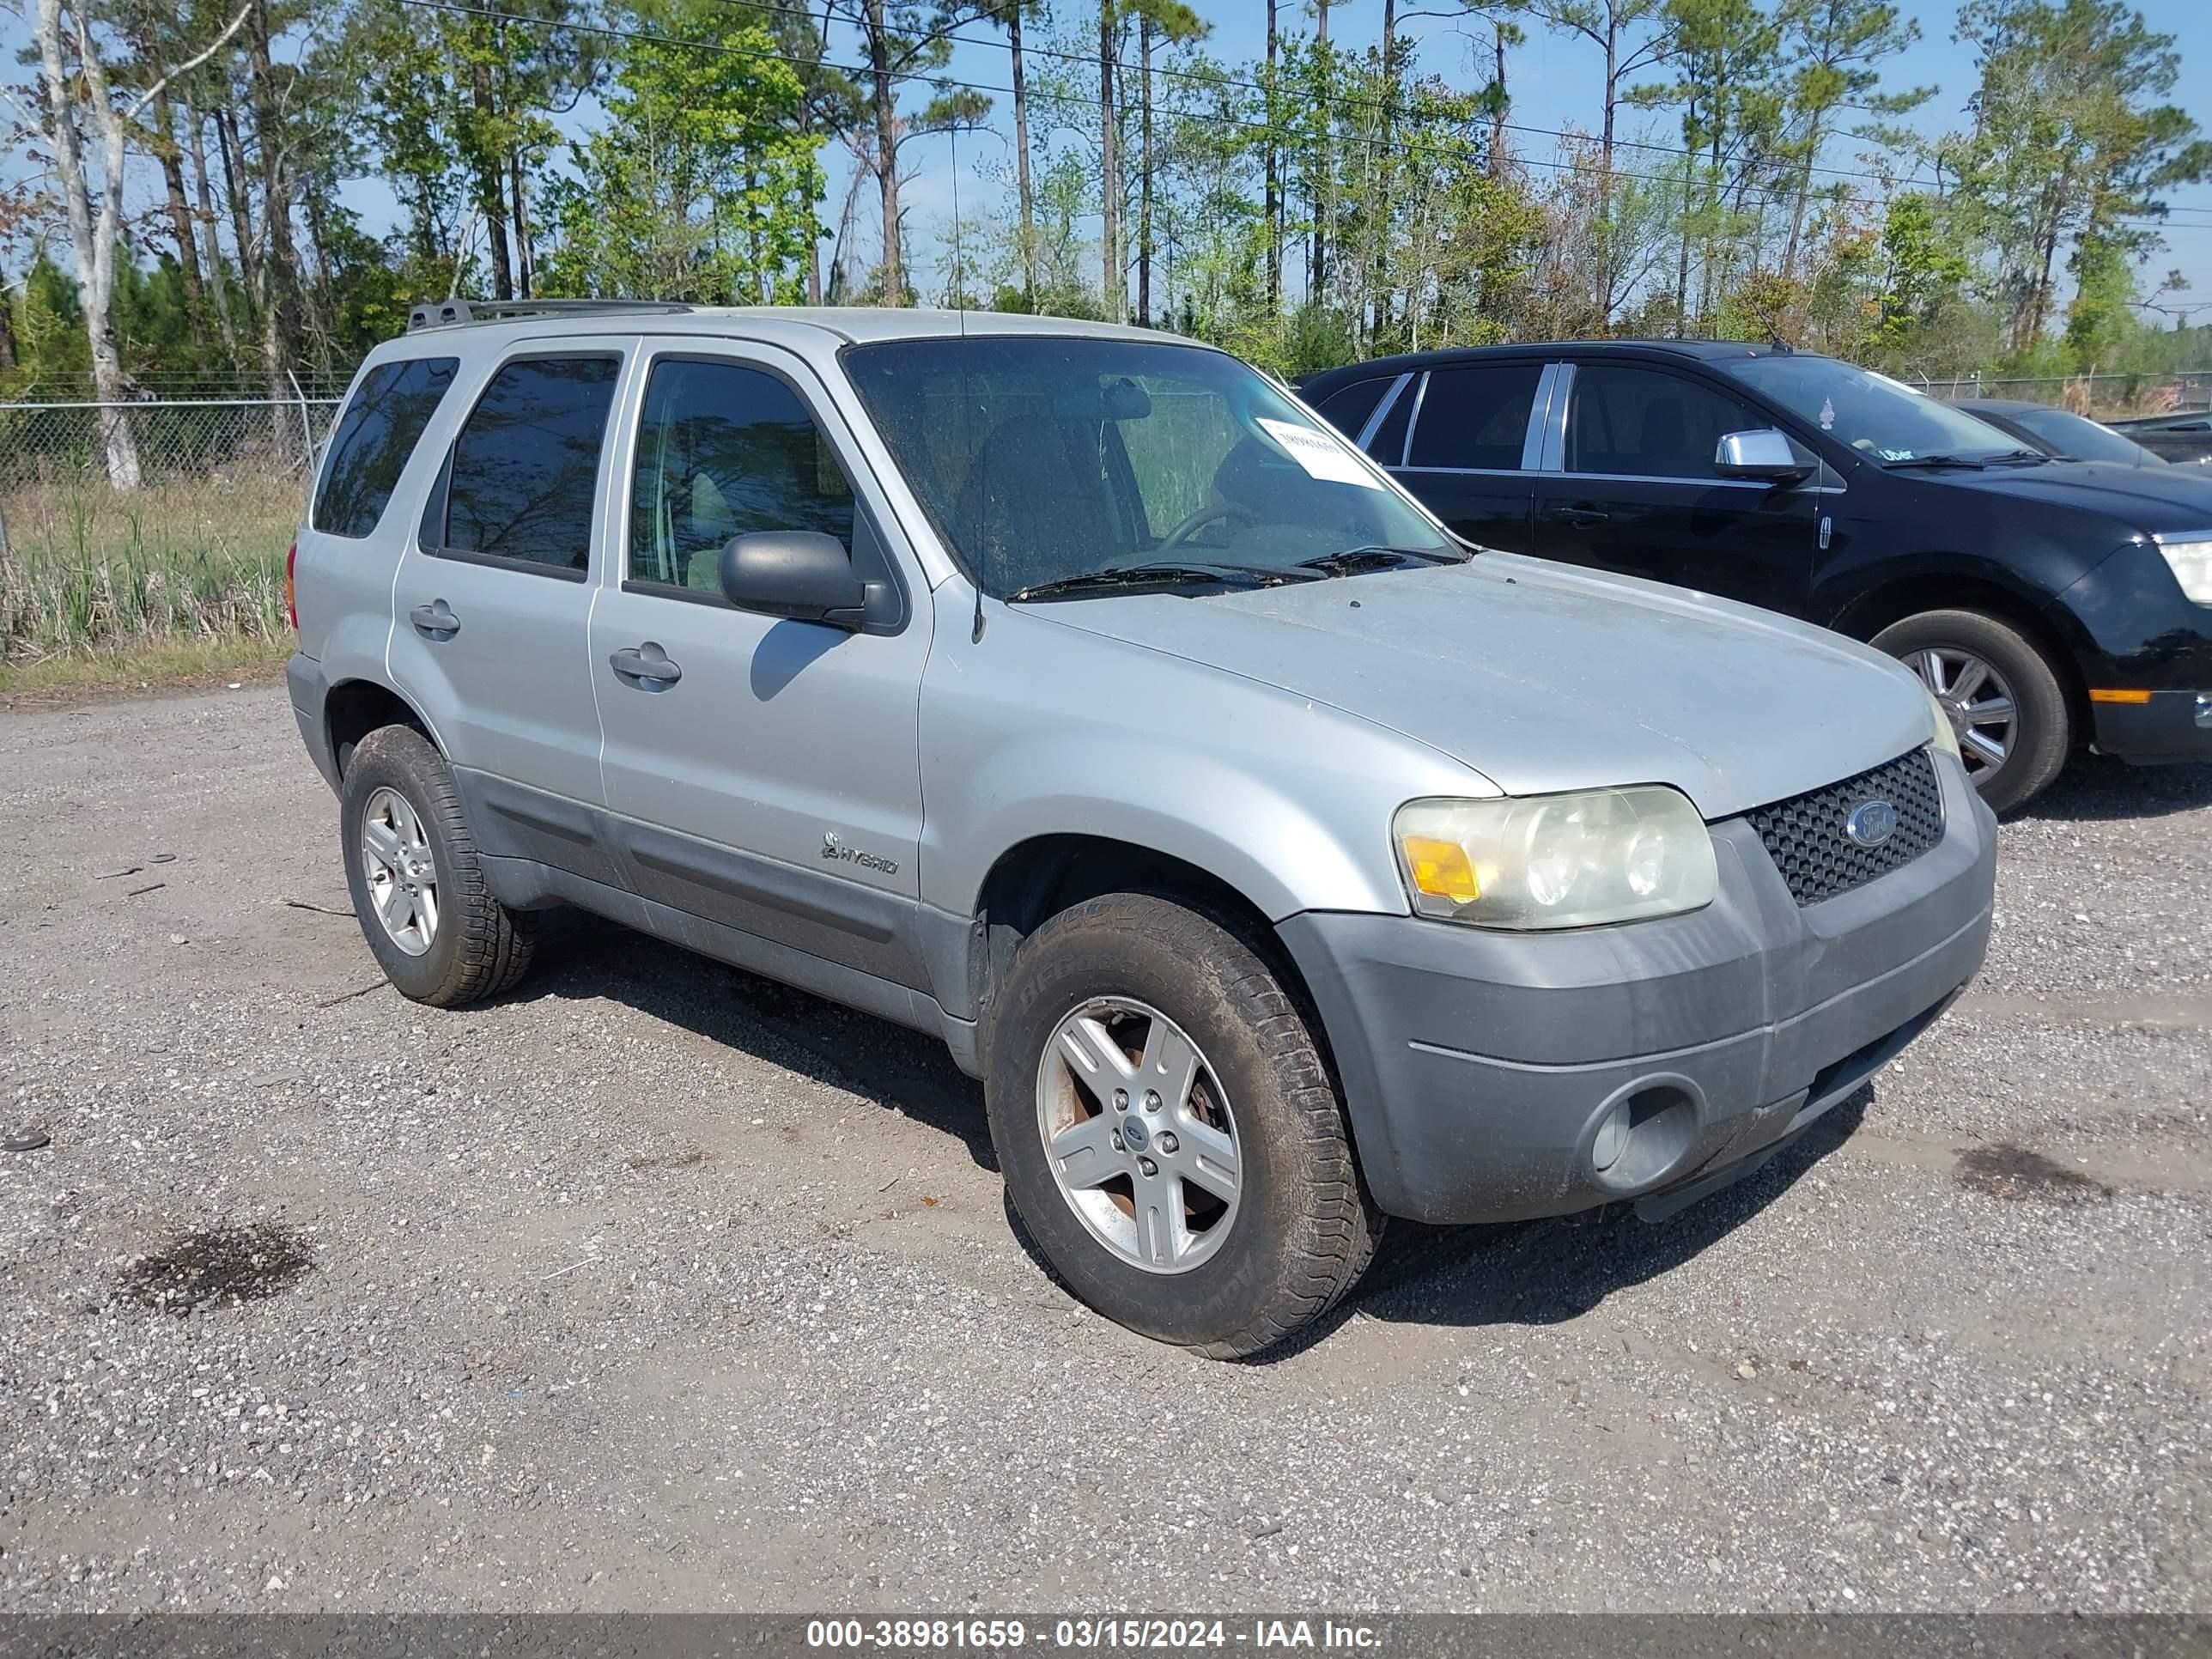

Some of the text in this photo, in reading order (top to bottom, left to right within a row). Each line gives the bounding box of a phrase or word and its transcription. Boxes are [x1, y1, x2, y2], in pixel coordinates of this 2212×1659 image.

[1878, 449, 1914, 461] Uber
[1863, 810, 1887, 838] Ford
[840, 847, 899, 874] HYBRID
